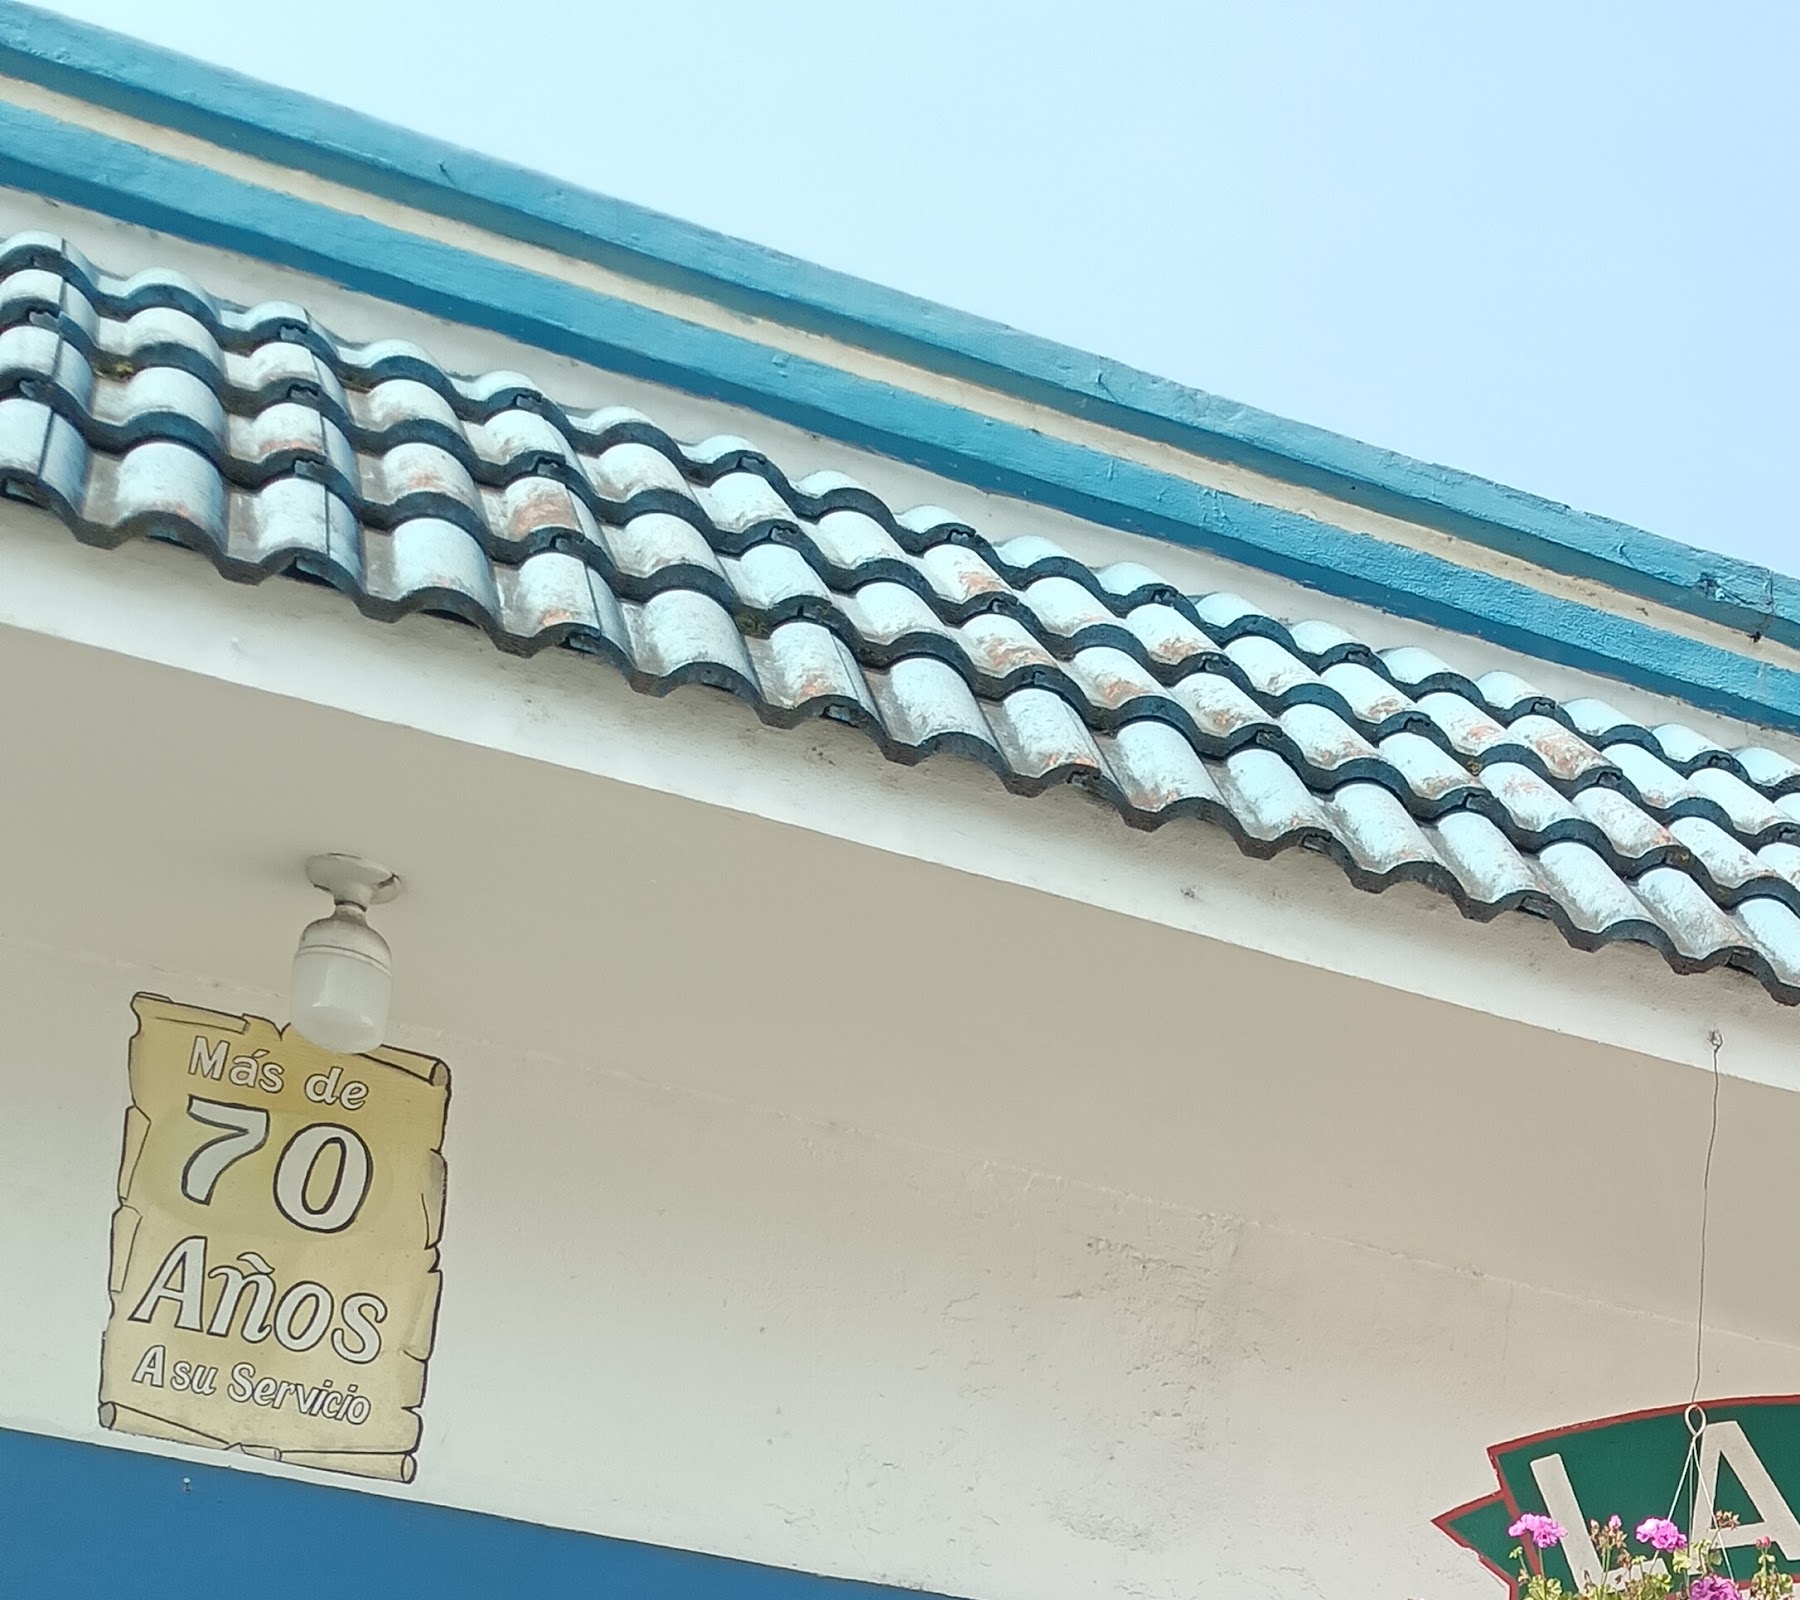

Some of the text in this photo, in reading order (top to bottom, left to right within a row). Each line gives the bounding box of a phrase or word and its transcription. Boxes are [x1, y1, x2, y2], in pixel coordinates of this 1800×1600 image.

[187, 1035, 370, 1110] Más de
[181, 1095, 373, 1234] 70
[227, 1362, 373, 1425] Servicio
